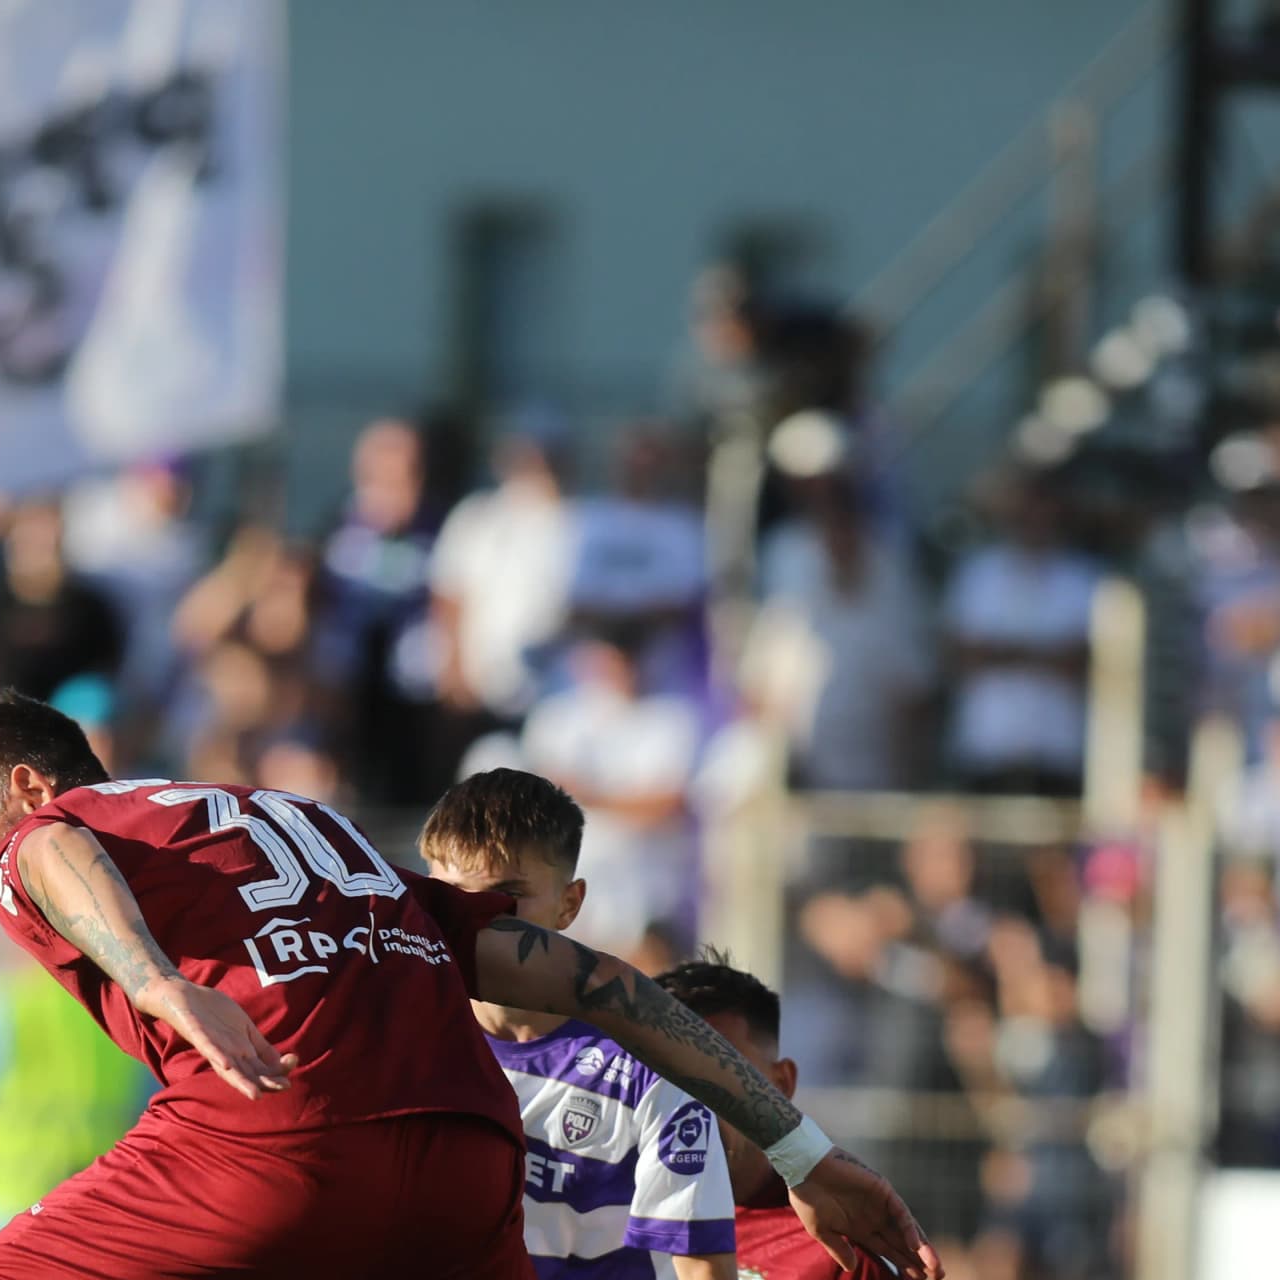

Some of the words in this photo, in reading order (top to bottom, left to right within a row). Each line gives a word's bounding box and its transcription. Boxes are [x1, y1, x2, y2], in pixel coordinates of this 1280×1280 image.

[146, 788, 408, 913] 30
[566, 1111, 593, 1132] POLI
[668, 1152, 706, 1164] EGERI
